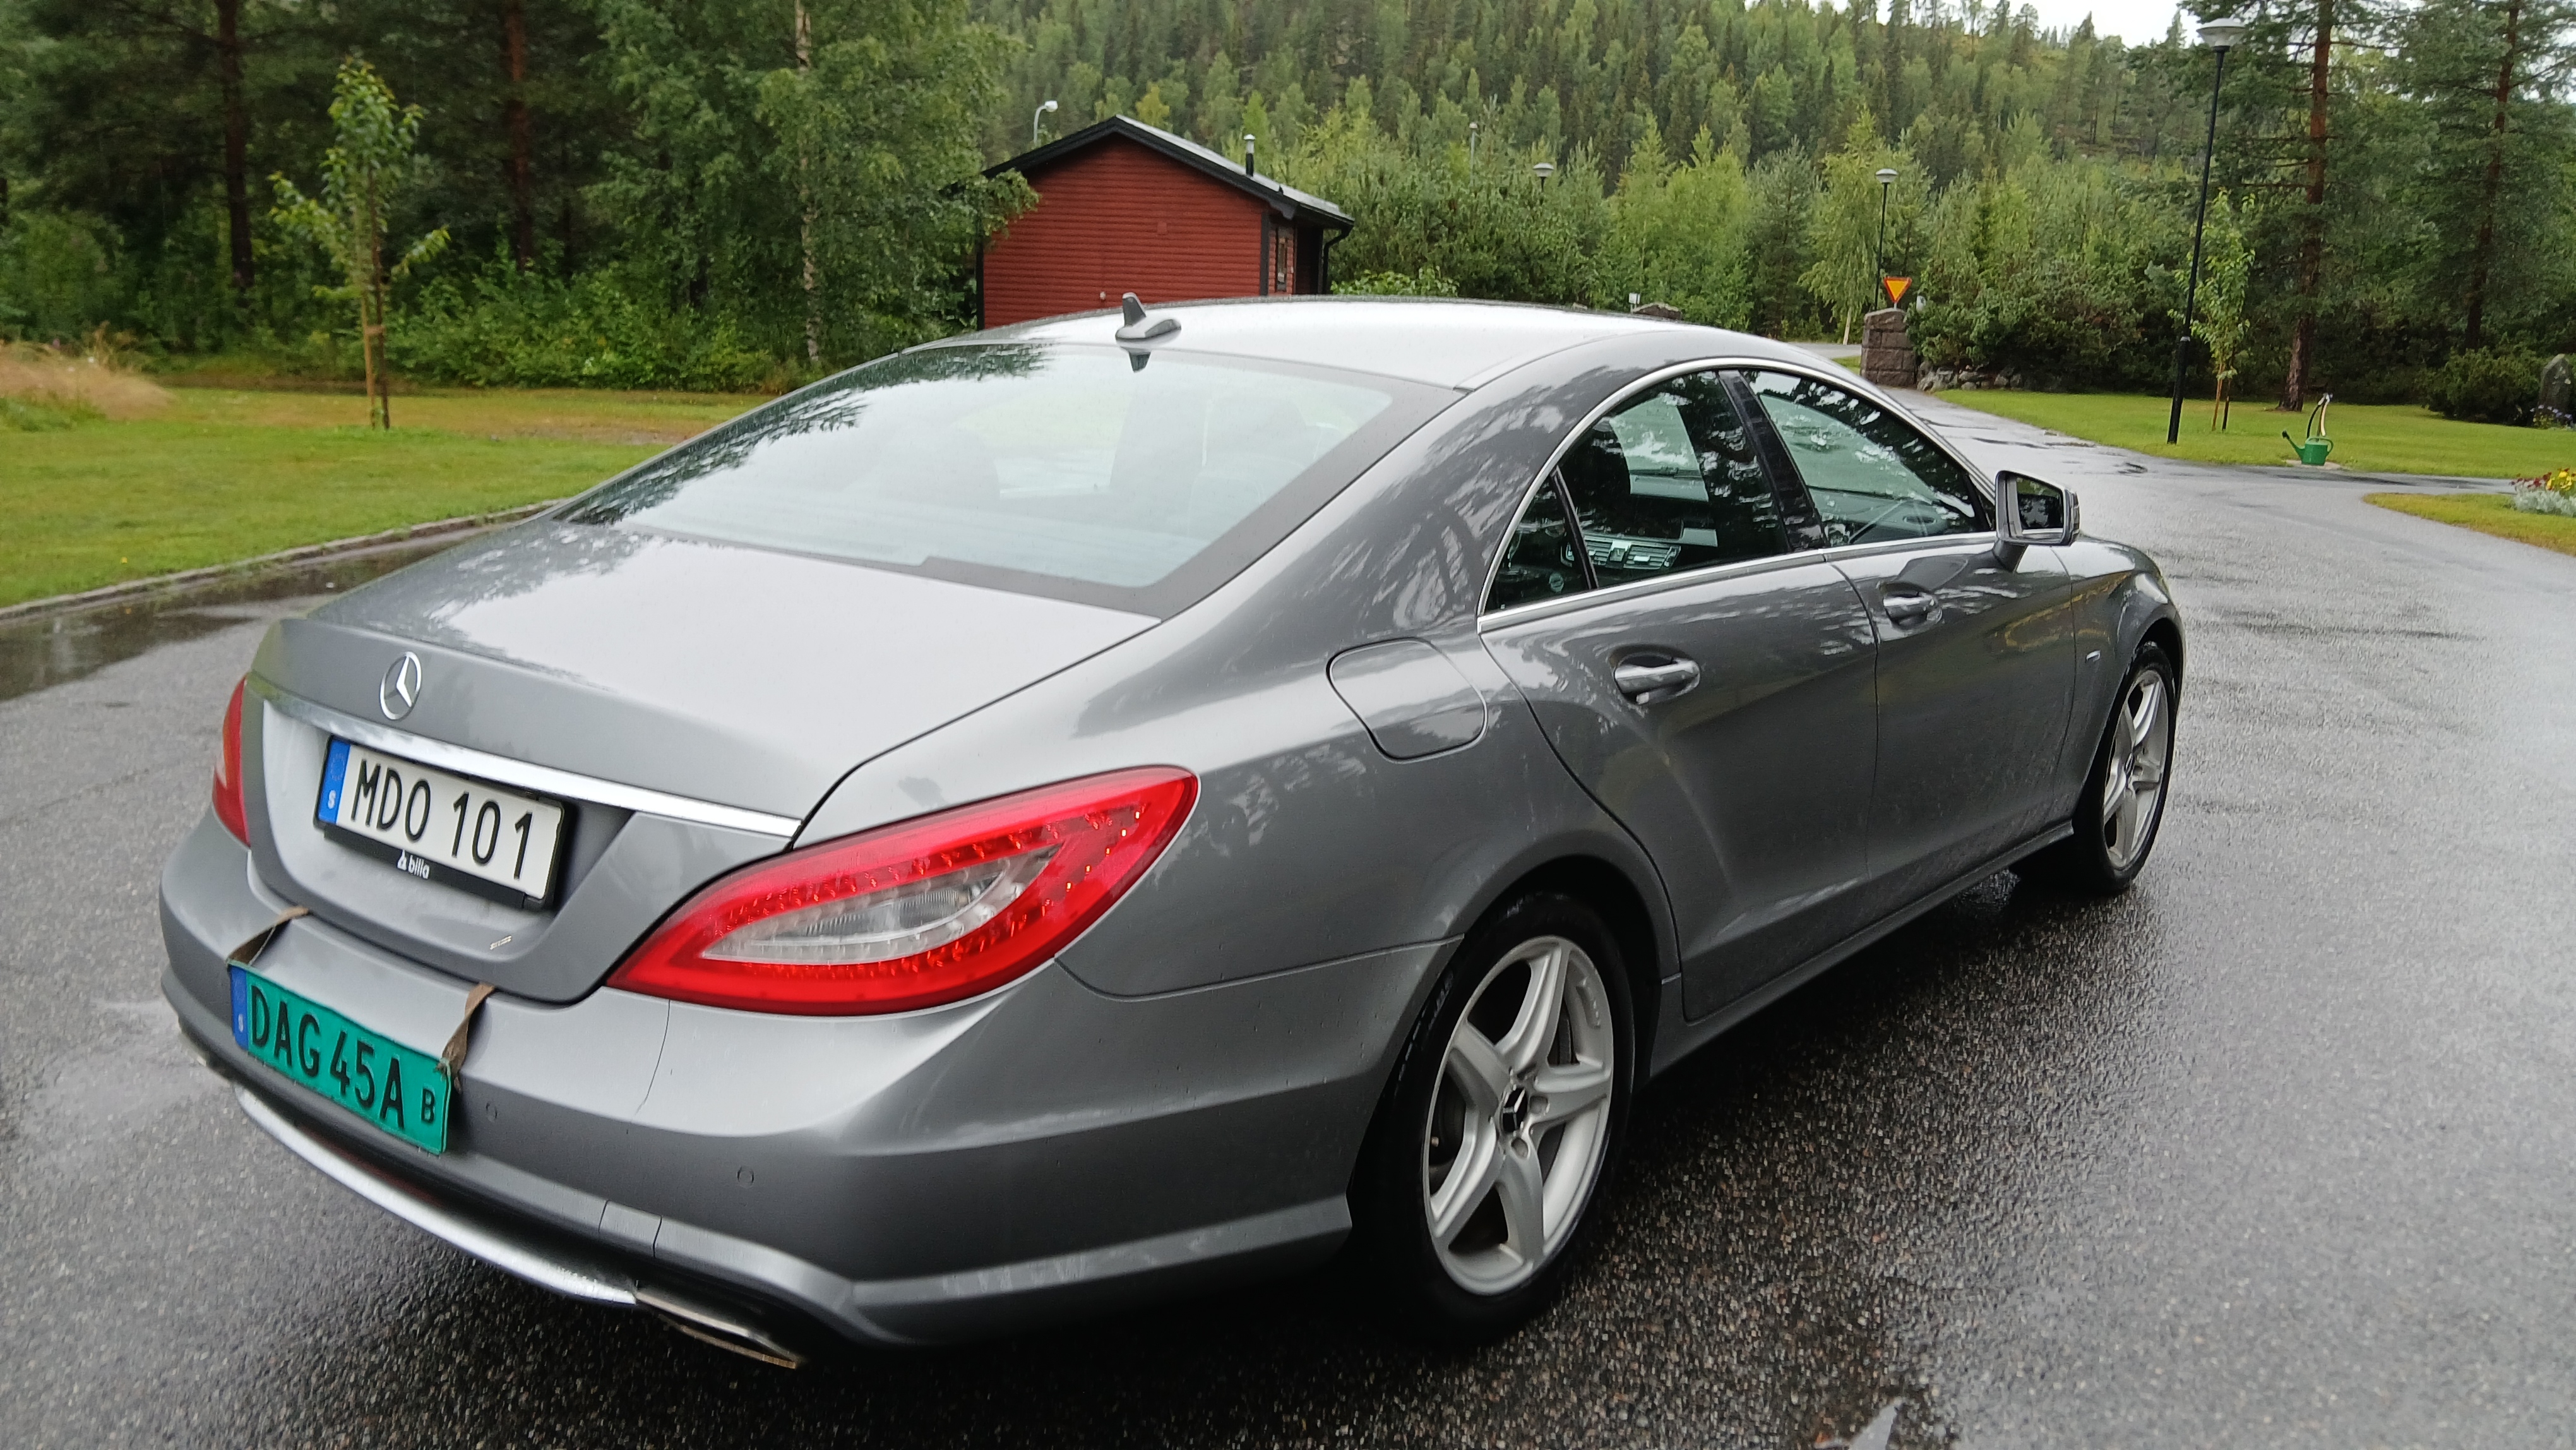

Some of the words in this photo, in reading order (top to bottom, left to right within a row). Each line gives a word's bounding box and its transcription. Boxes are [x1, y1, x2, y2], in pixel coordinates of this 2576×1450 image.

[328, 789, 336, 809] S
[350, 758, 431, 842] MDO
[453, 791, 533, 880] 101
[420, 1088, 436, 1124] B
